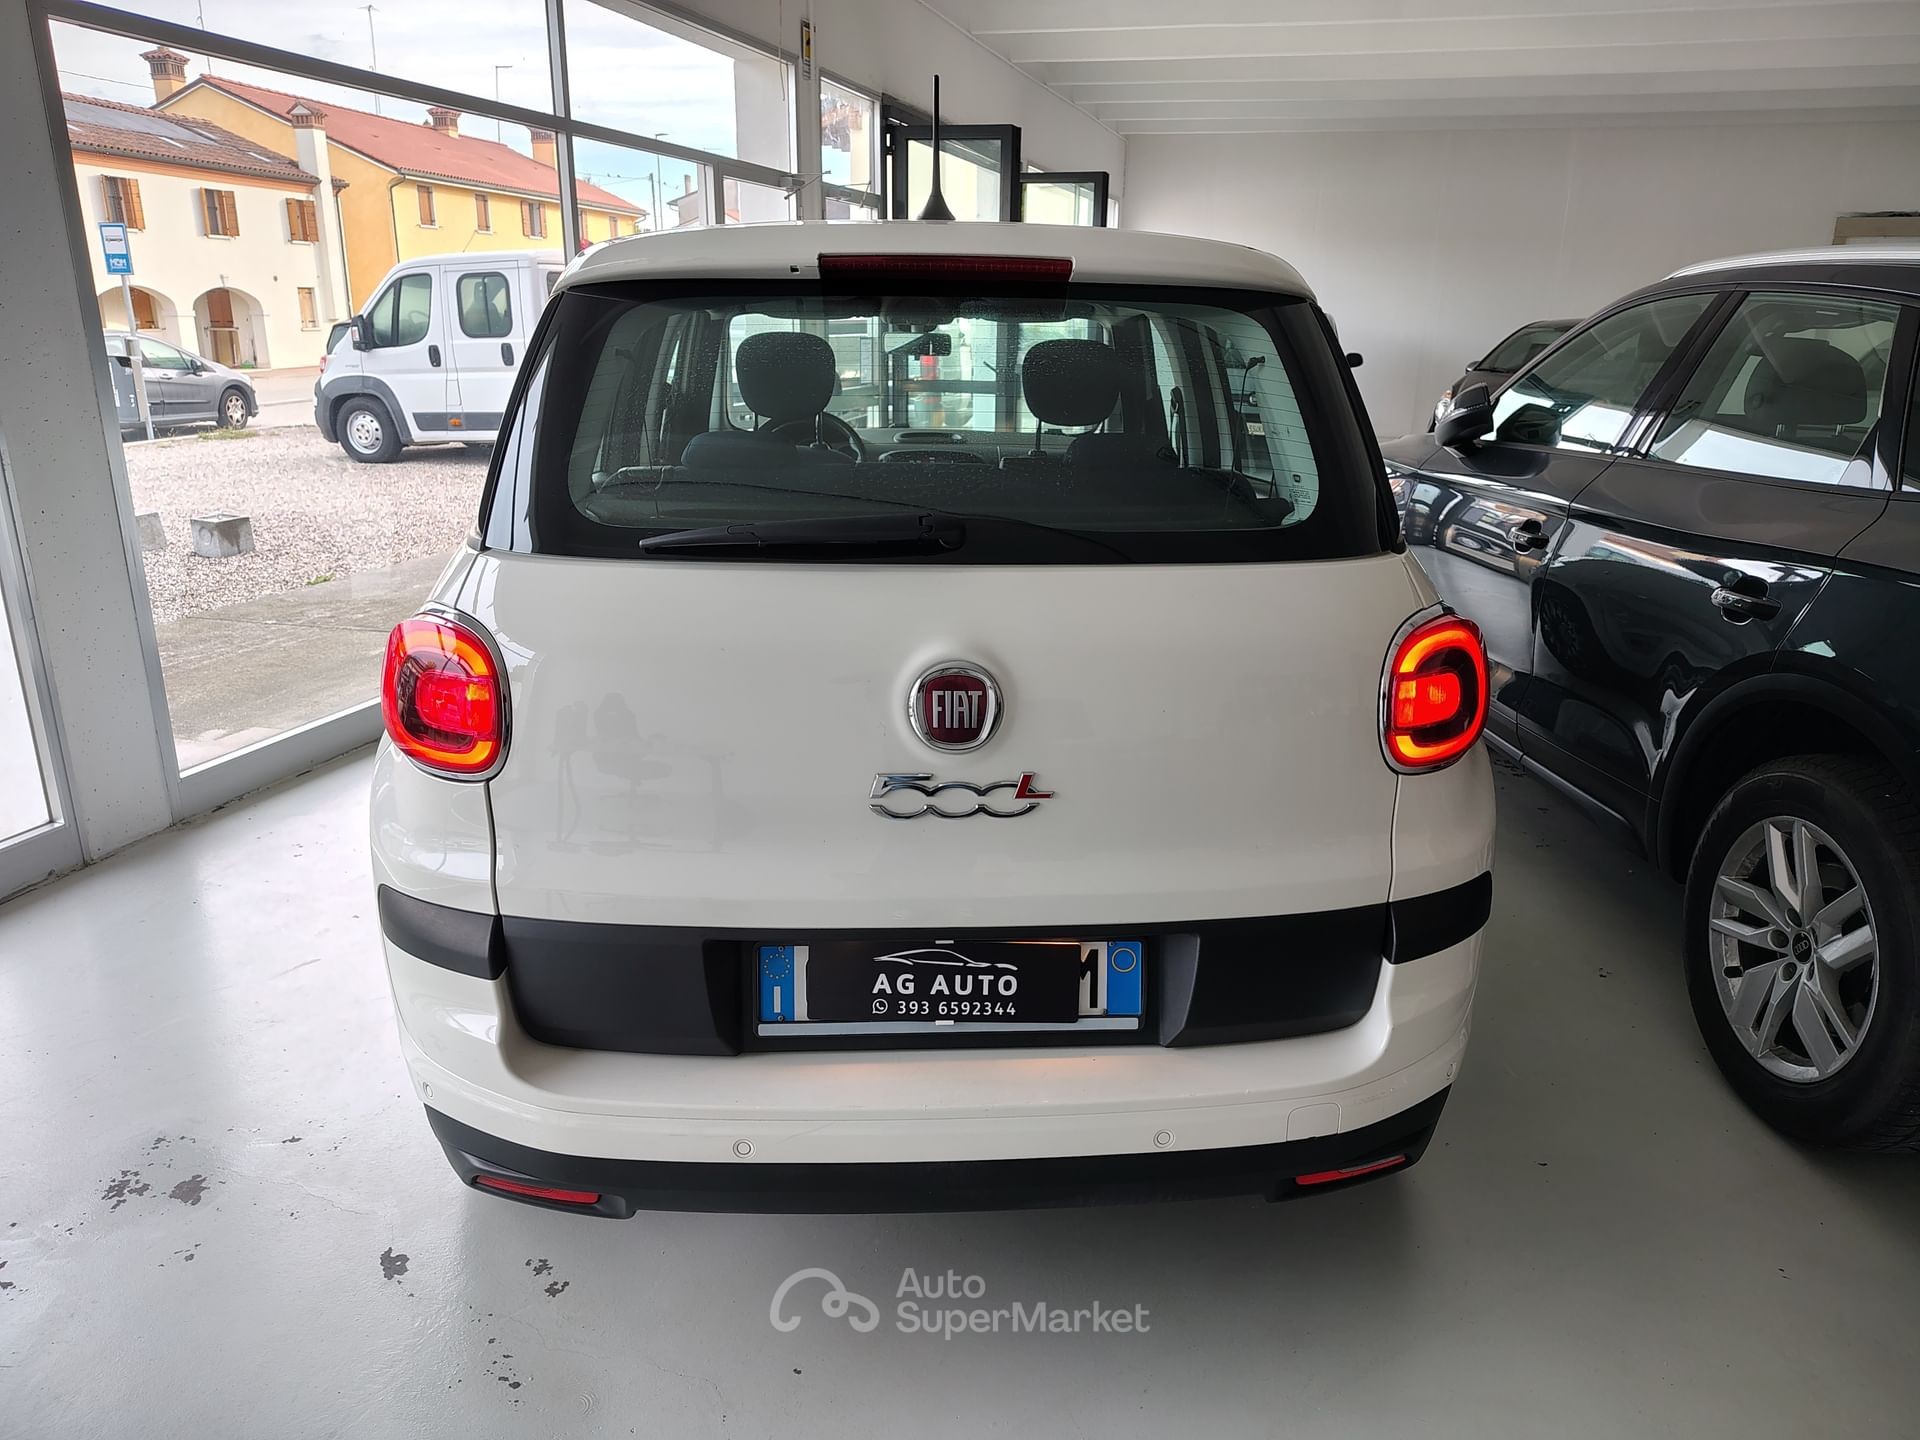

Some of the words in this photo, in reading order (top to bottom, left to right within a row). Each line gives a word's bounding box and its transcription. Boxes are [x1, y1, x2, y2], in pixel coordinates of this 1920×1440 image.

[932, 690, 982, 729] FIAT
[868, 771, 1056, 820] 500L
[872, 973, 916, 995] AG
[930, 974, 1018, 996] AUTO
[898, 1000, 929, 1015] 393
[938, 1001, 1016, 1016] 6592344
